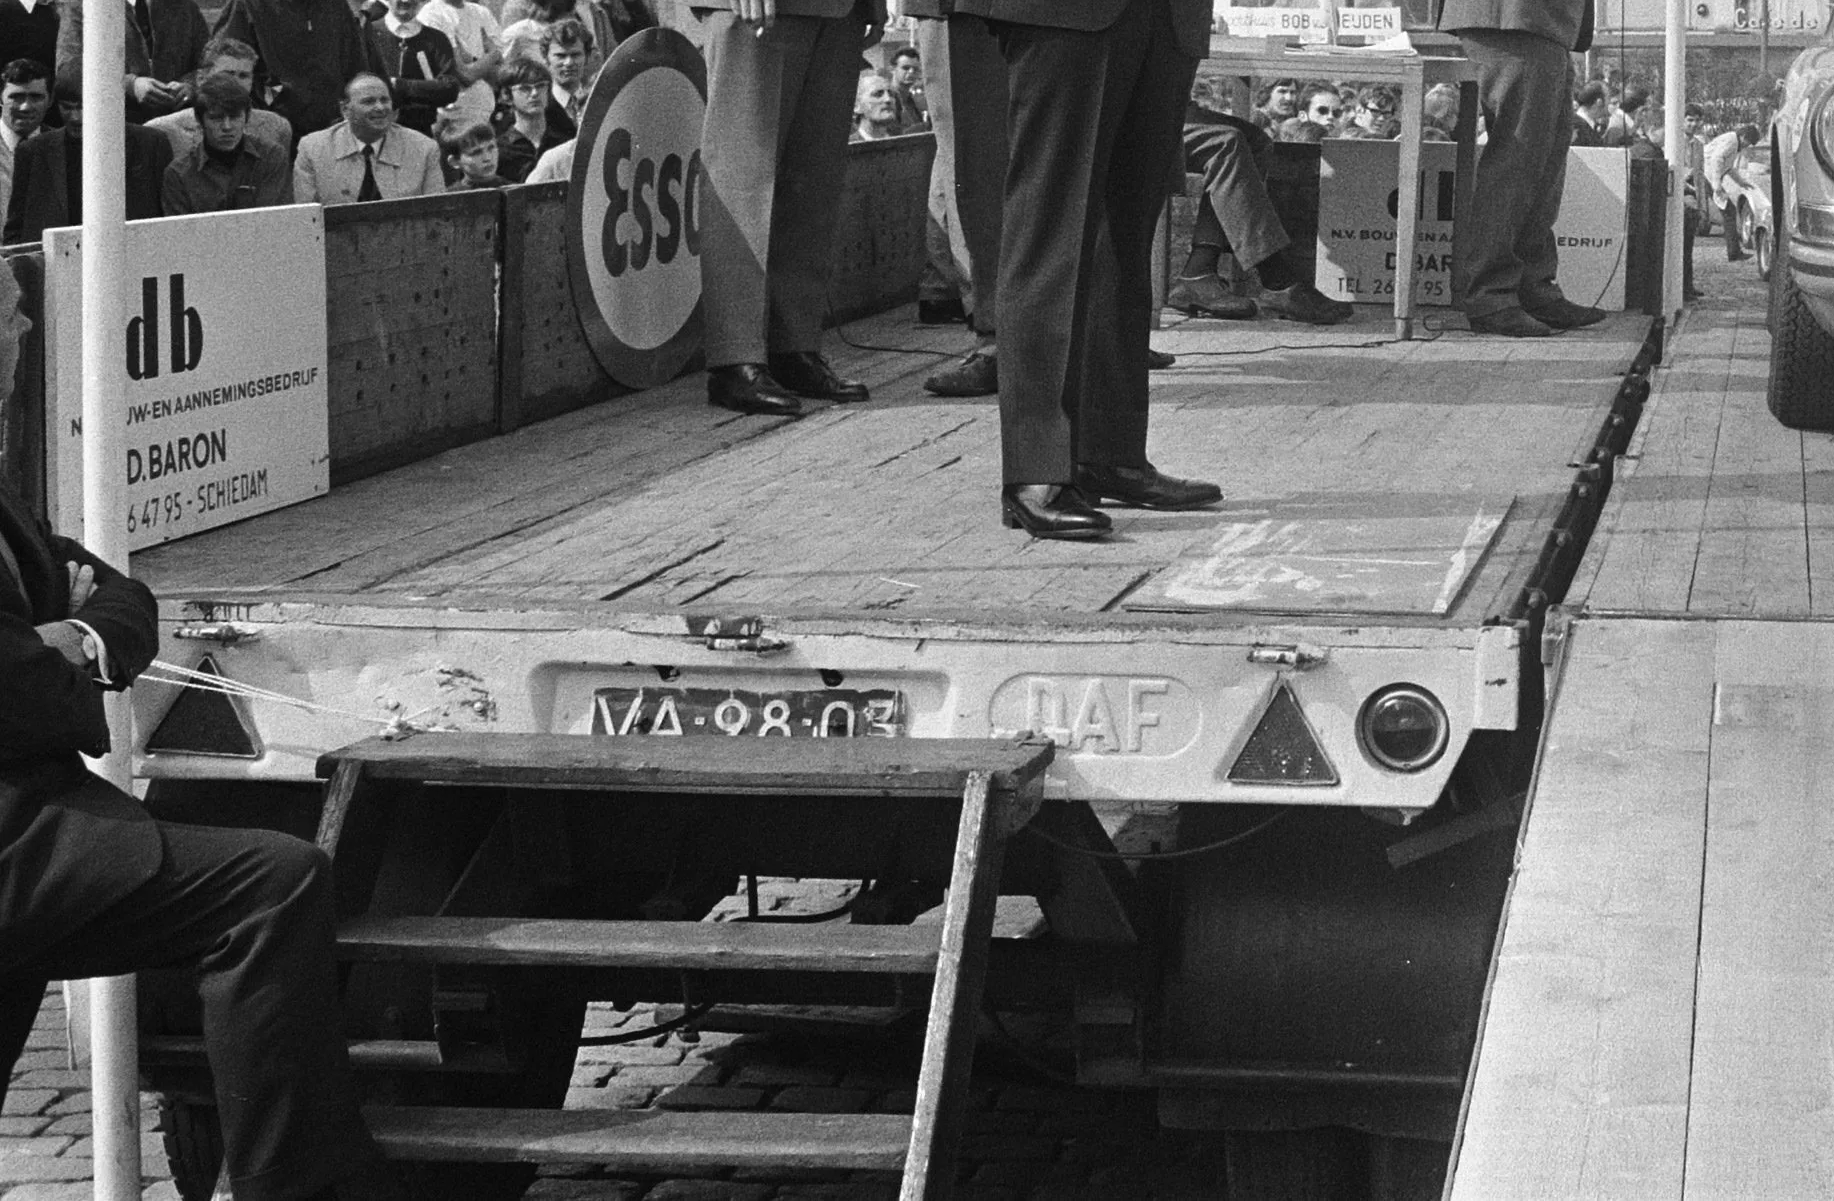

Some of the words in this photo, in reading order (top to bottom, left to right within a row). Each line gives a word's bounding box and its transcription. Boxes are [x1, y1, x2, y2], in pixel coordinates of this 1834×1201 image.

[1281, 13, 1311, 30] BOB
[1341, 13, 1394, 30] EIJDEN
[1331, 229, 1357, 240] N.V.
[1373, 279, 1394, 295] 26
[1424, 281, 1444, 296] 95
[125, 273, 203, 381] db
[174, 367, 318, 414] AANNEMINGSBEDRIJF
[164, 492, 182, 523] 95
[198, 468, 268, 514] SCHIEDAM
